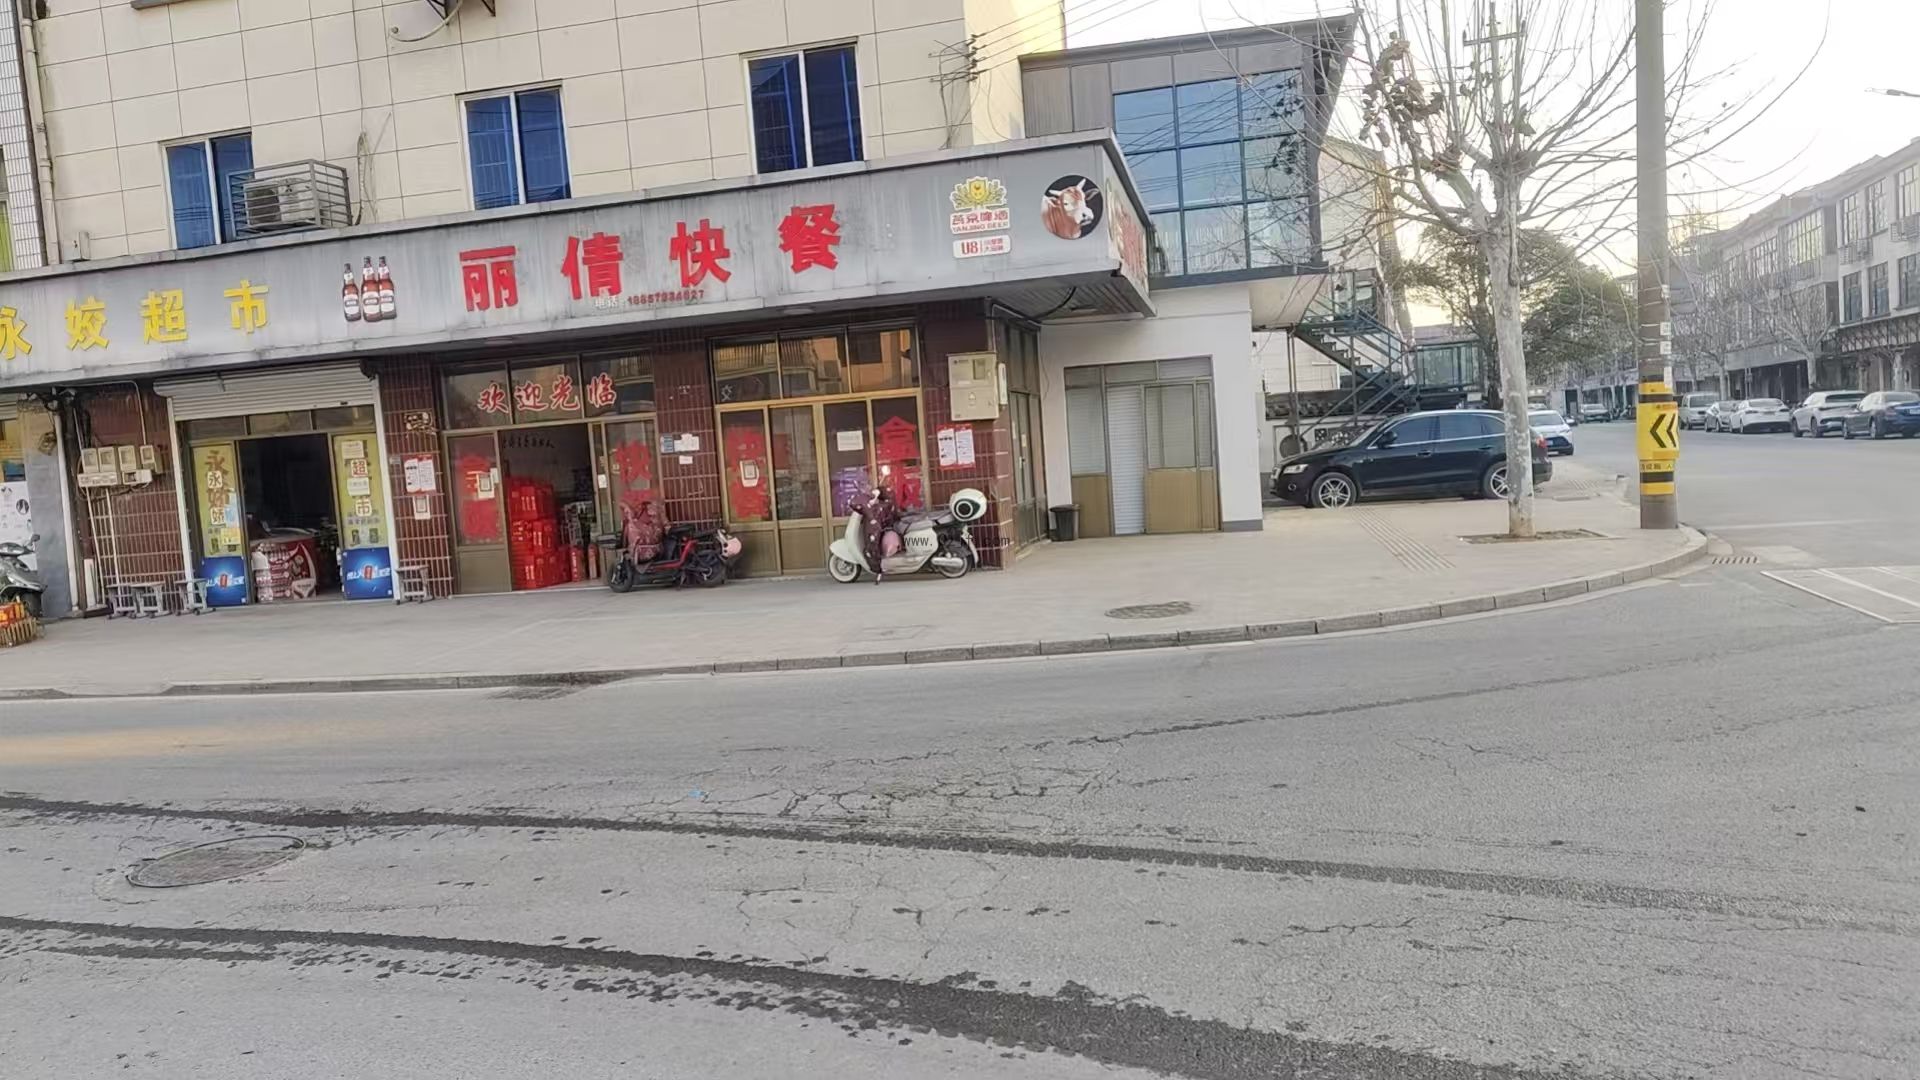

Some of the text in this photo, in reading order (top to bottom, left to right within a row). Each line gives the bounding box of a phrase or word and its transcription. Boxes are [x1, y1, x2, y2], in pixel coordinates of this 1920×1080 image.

[460, 204, 841, 312] 丽倩快餐
[961, 240, 979, 254] U8
[478, 372, 617, 414] 欢迎光临
